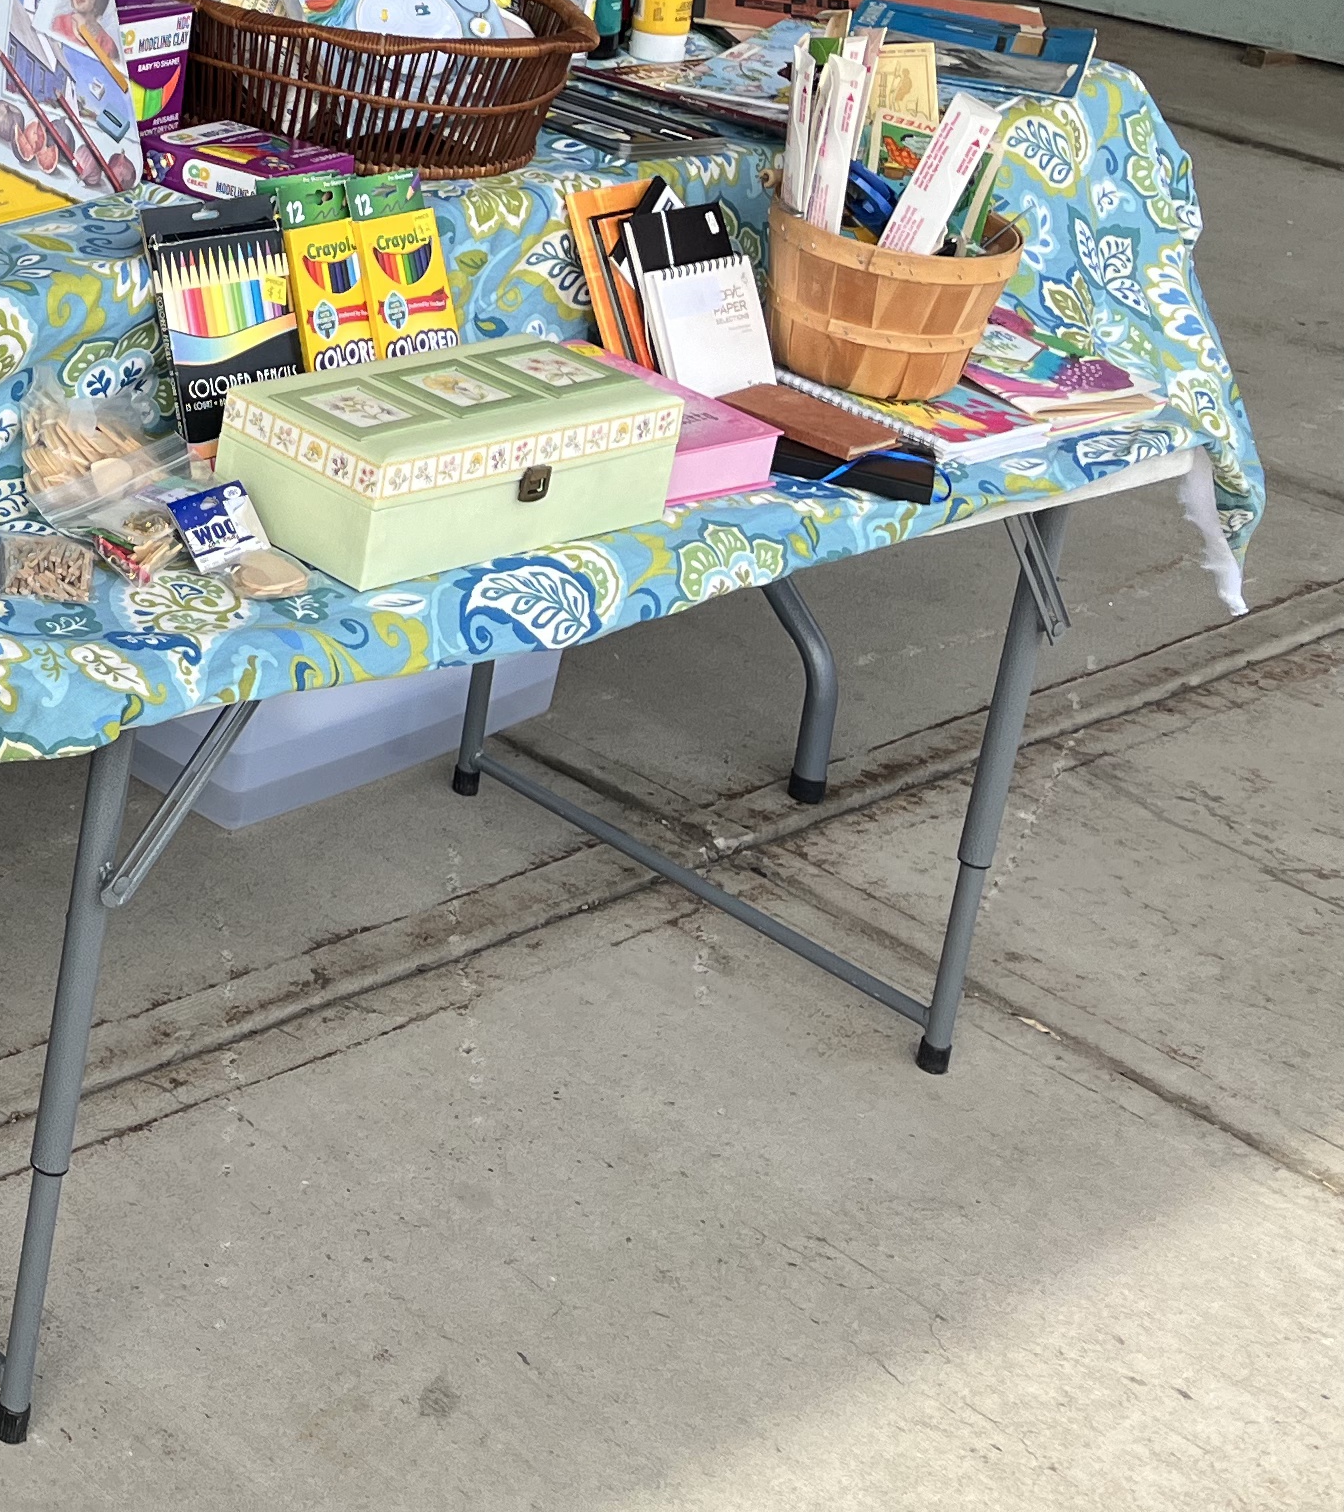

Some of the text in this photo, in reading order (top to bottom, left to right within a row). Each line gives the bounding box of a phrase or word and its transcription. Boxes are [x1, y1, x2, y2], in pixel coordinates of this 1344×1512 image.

[138, 30, 189, 54] MODELING CLAY
[285, 200, 306, 225] 12
[354, 193, 374, 217] 12
[314, 338, 376, 373] COLORE
[385, 328, 459, 360] COLORED
[191, 517, 237, 546] WOO
